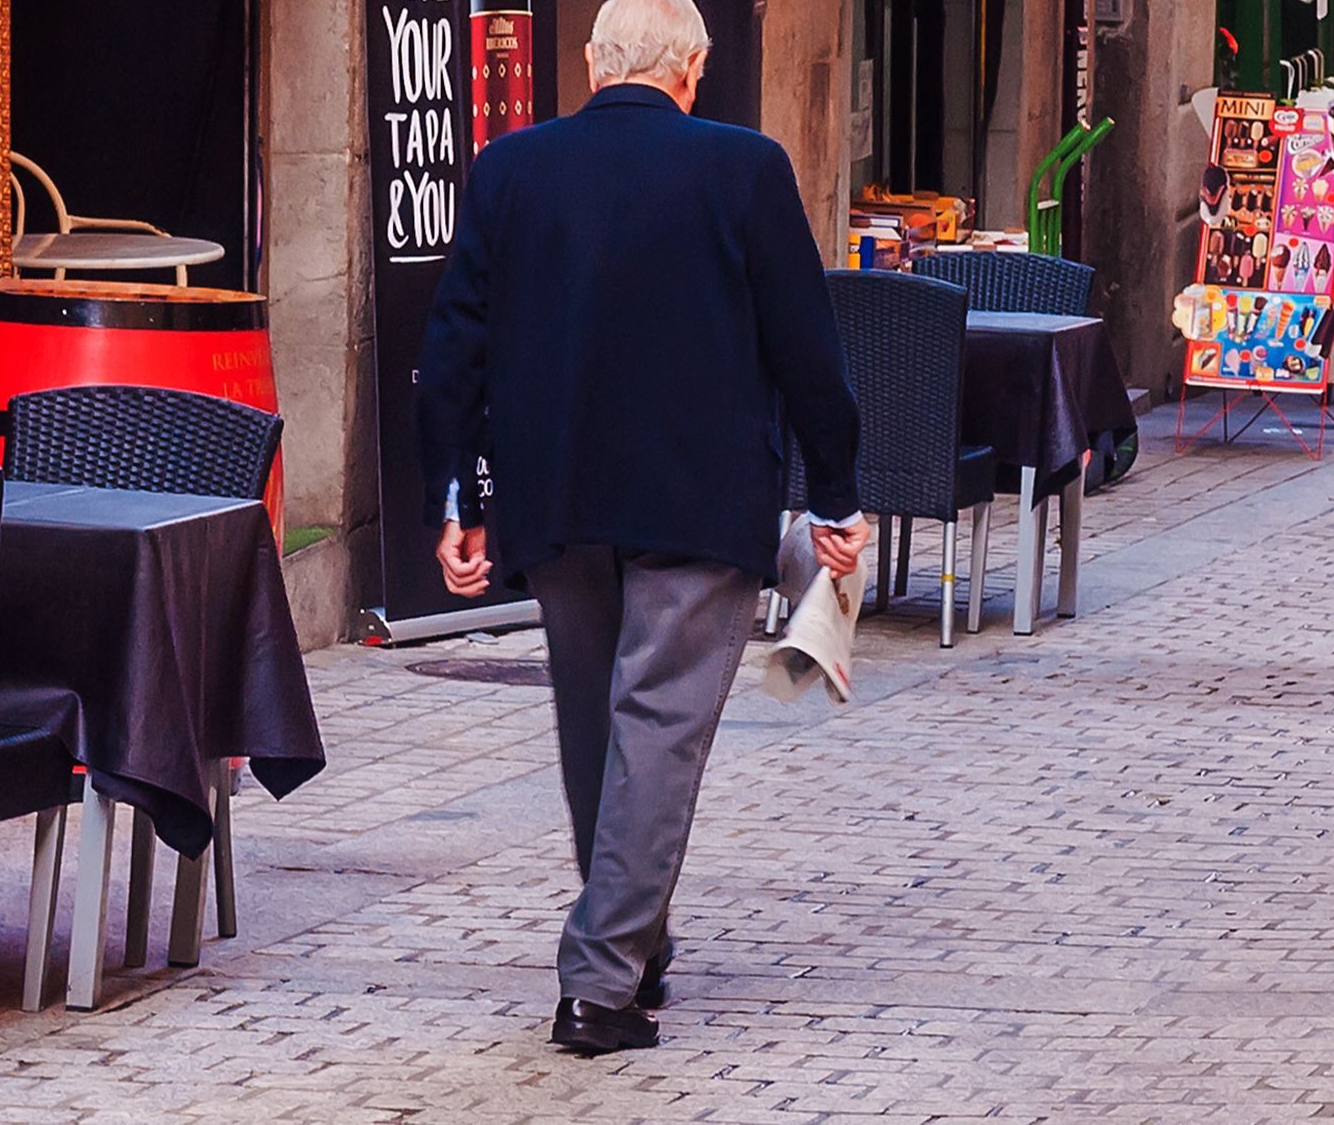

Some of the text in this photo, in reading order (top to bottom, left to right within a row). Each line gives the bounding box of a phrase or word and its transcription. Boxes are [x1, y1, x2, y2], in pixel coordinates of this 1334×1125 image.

[382, 5, 454, 106] YOUR
[1220, 99, 1266, 116] MINI
[383, 108, 455, 169] TAPA
